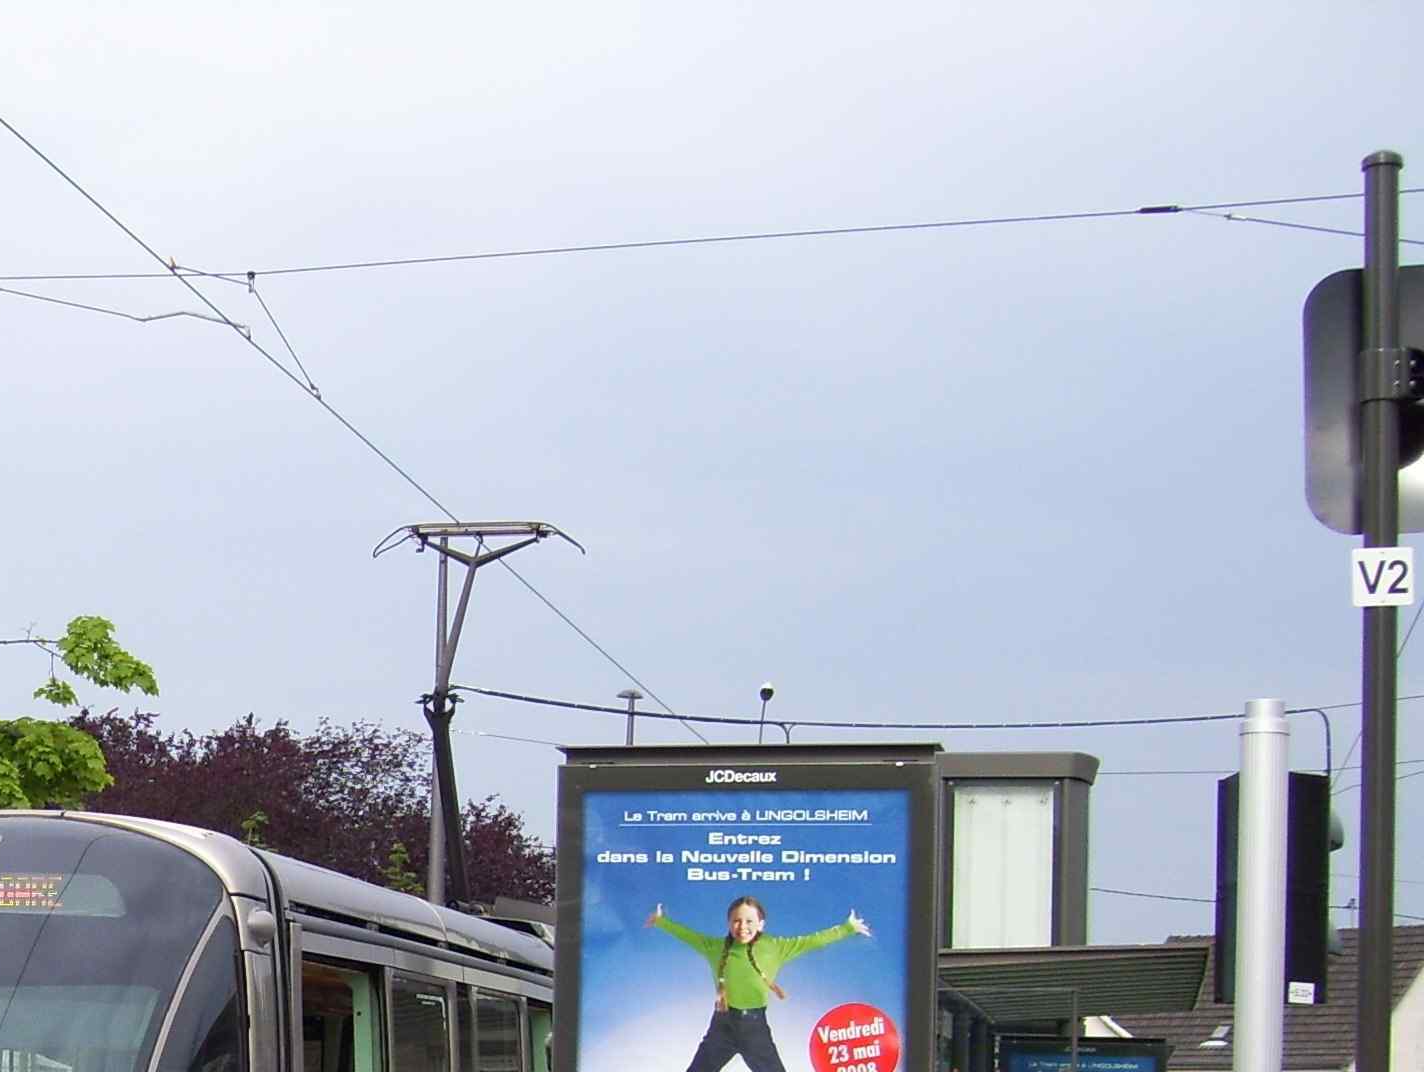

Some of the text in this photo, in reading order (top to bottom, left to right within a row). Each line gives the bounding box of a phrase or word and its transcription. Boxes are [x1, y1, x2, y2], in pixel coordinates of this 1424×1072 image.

[1357, 559, 1409, 594] V2
[706, 770, 777, 783] JCDecaux
[624, 809, 868, 822] Le Tram arrive à LINGOLSHEIM
[708, 833, 782, 845] Entrez
[597, 850, 896, 864] dans la Nouvelle Dimension
[687, 868, 811, 881] Bus-Tram !
[817, 1017, 885, 1043] Vendredi
[828, 1040, 881, 1064] 23 mai
